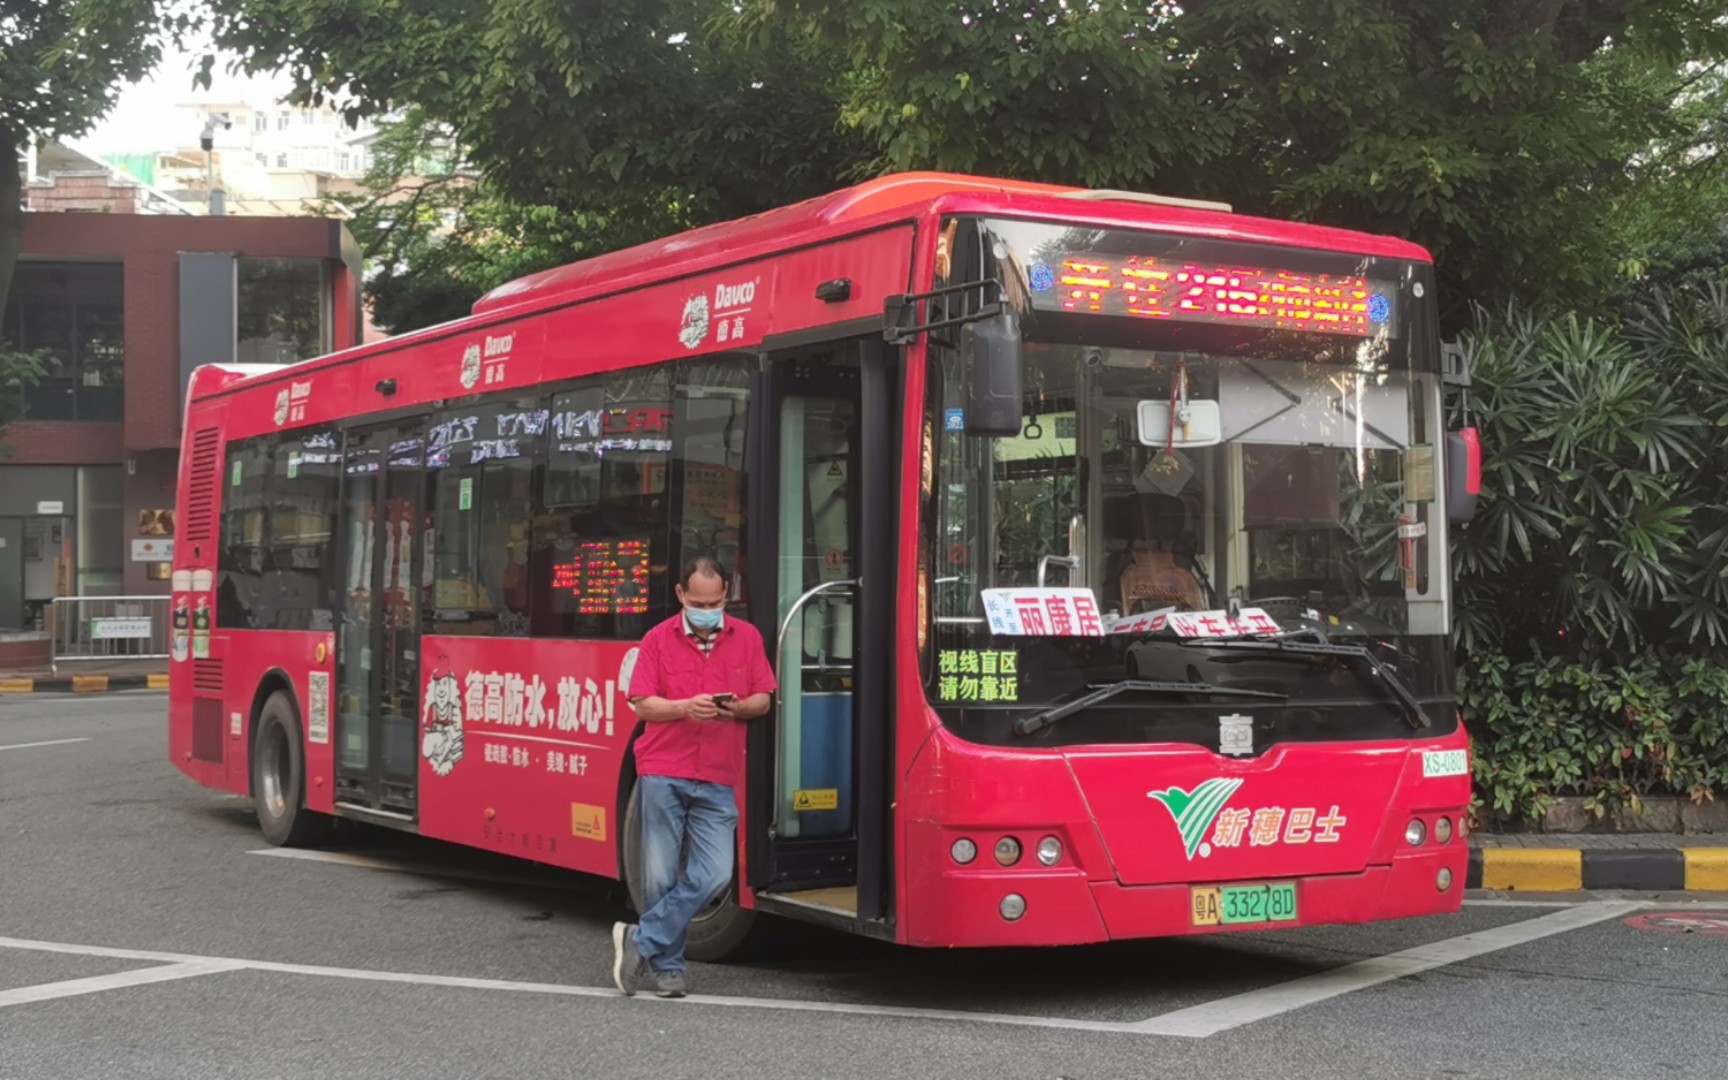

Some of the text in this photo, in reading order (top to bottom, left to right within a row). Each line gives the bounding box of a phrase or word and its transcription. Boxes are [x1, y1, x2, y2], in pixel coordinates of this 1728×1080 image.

[717, 316, 745, 342] 德高
[1014, 594, 1101, 637] 丽康居
[938, 649, 1018, 674] 视线盲区
[938, 675, 1018, 701] 请勿靠近
[1424, 752, 1466, 774] XS-0801
[1212, 805, 1347, 847] 新穗巴士
